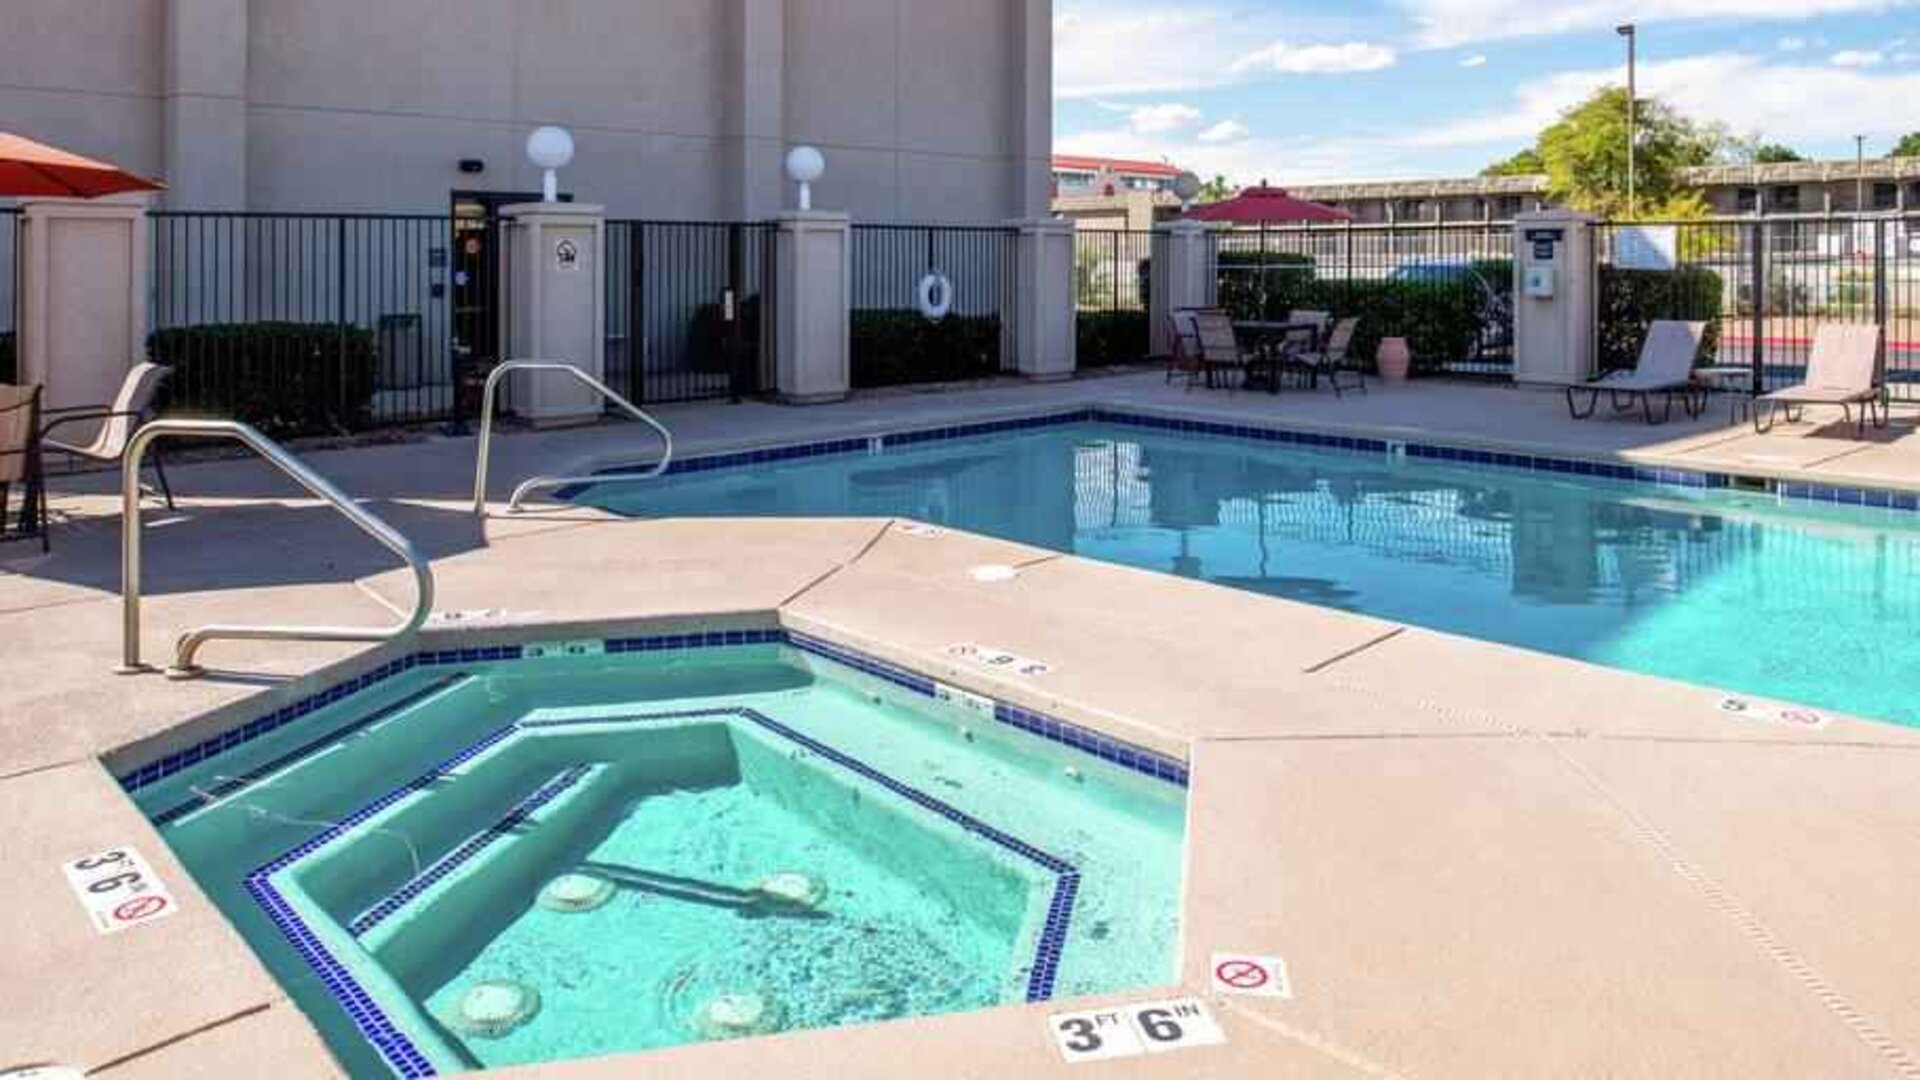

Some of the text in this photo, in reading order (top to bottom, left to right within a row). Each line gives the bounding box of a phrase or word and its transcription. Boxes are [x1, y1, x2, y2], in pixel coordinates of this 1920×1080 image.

[74, 851, 141, 893] 3 6
[1059, 1018, 1103, 1052] 3
[1137, 1008, 1183, 1042] 6
